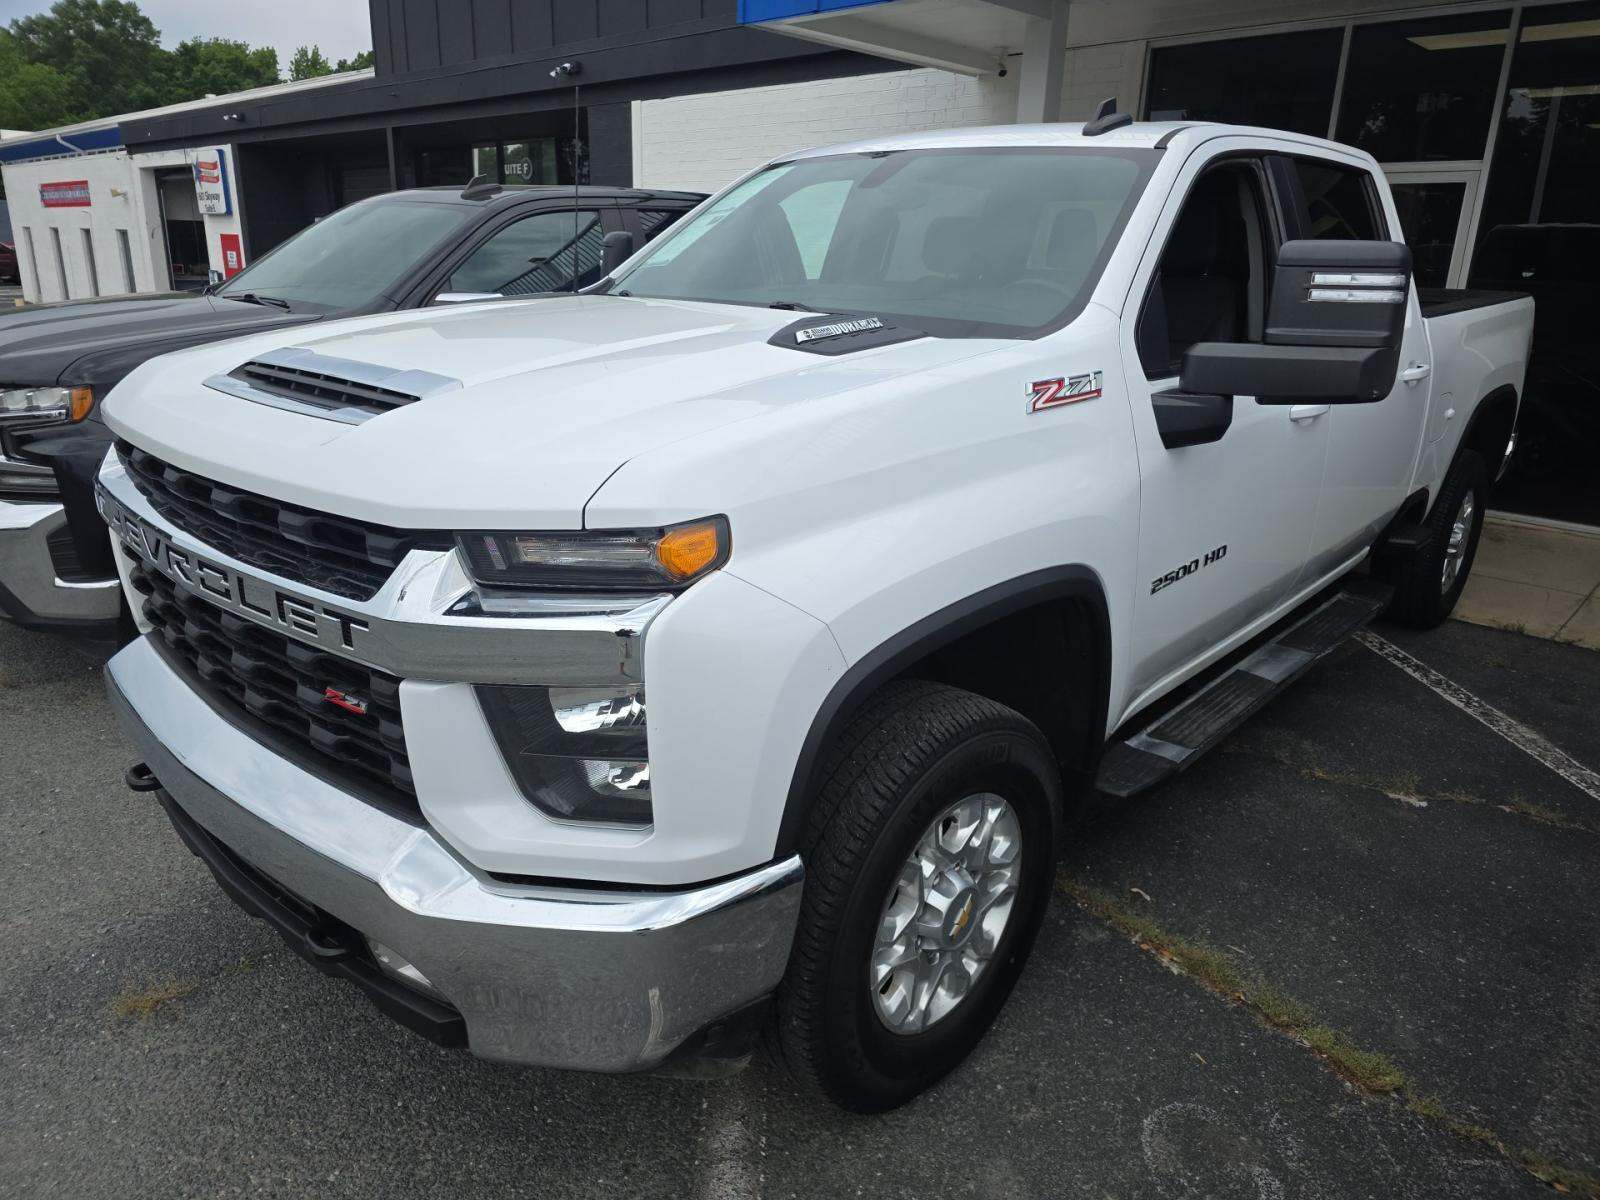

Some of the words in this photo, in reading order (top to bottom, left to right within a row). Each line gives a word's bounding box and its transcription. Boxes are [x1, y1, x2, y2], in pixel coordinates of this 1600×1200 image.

[504, 163, 522, 175] UITE
[831, 317, 884, 335] DURAMAX
[1025, 370, 1102, 415] Z71
[1150, 558, 1199, 595] 2500
[1203, 545, 1227, 568] HD
